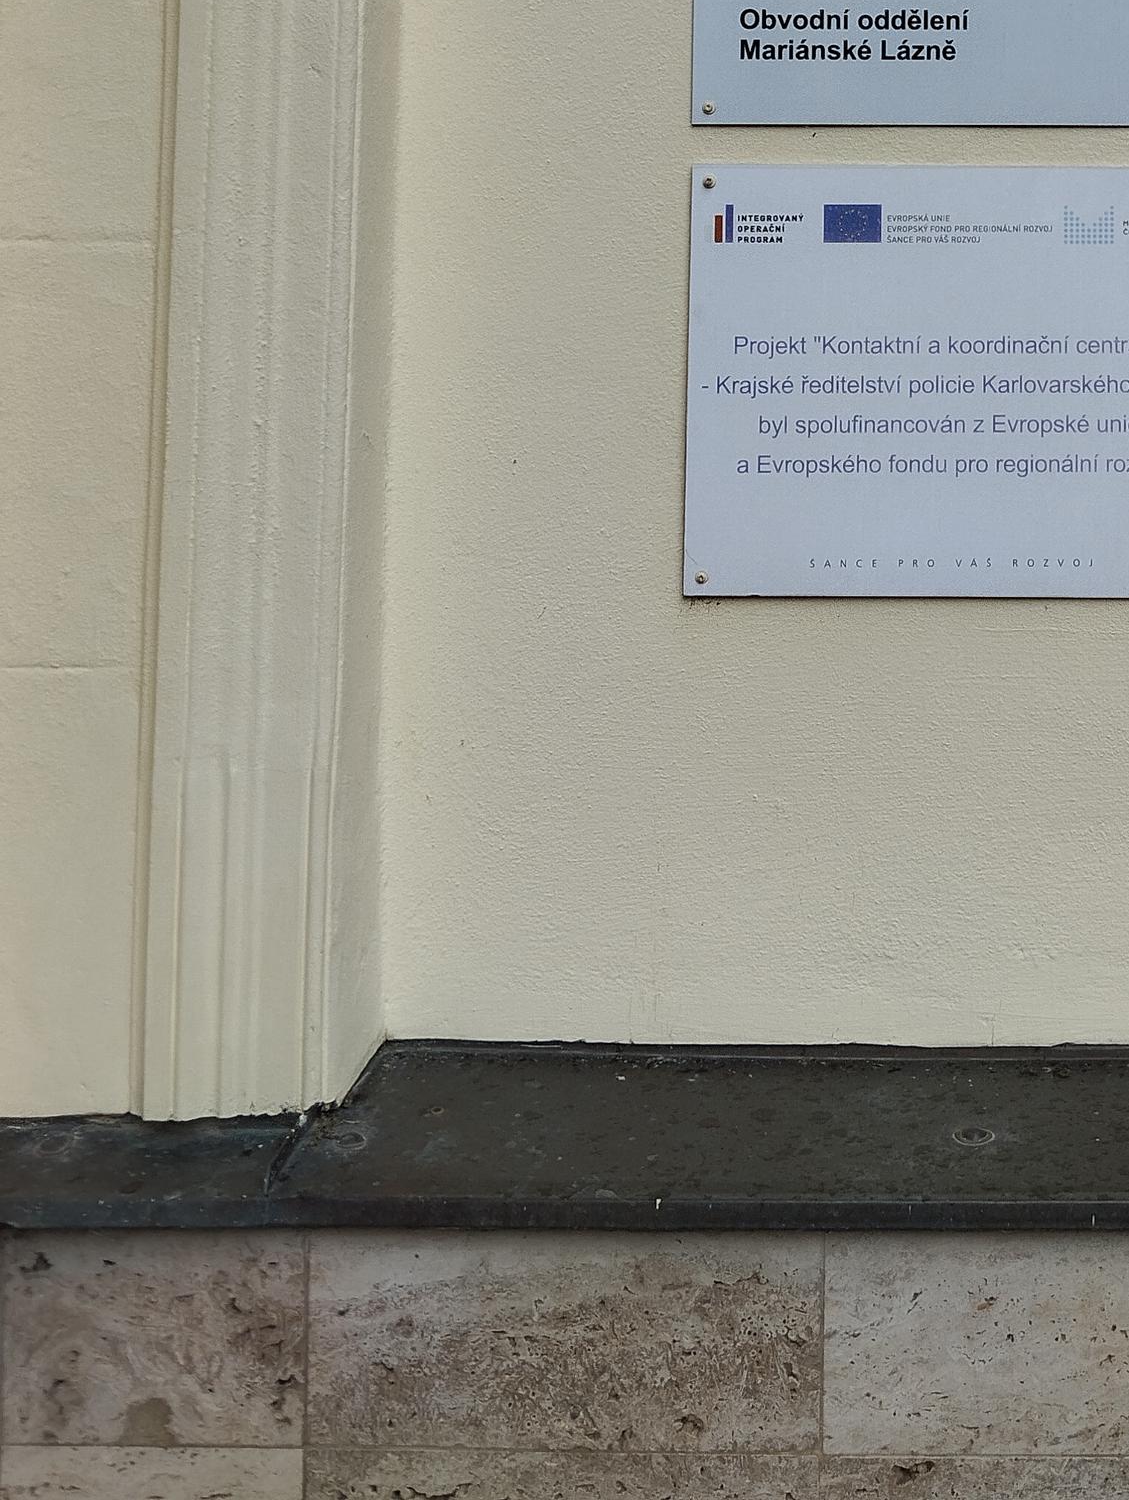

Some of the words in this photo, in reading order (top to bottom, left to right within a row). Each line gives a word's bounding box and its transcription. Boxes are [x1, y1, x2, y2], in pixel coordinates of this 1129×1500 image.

[739, 8, 851, 31] Obvodní
[857, 8, 970, 31] oddělení
[739, 38, 872, 62] Mariánské
[880, 39, 957, 62] Lázně
[737, 213, 804, 222] INTEGROVANÝ
[886, 213, 929, 222] EVROPSKÁ
[930, 214, 951, 222] UNIE
[737, 223, 785, 233] OPERAČNÍ
[886, 223, 929, 233] EVROPSKÝ
[929, 224, 953, 233] FOND
[954, 224, 971, 233] PRO
[972, 223, 1022, 233] REGIONÁLNÍ
[1023, 224, 1053, 233] ROZVOJ
[737, 235, 783, 244] PROGRAM
[886, 234, 914, 244] ŠANCE
[915, 235, 933, 244] PRO
[933, 234, 950, 244] VÁŠ
[951, 235, 981, 244] ROZVOJ
[733, 335, 807, 359] Projekt
[813, 335, 922, 356] "Kontaktní
[928, 339, 941, 356] a
[948, 335, 1070, 356] koordinační
[716, 375, 794, 399] Krajské
[801, 374, 902, 395] ředitelství
[908, 374, 976, 399] policie
[758, 414, 789, 439] byl
[795, 414, 966, 438] spolufinancován
[972, 419, 985, 434] z
[992, 413, 1090, 439] Evropské
[736, 459, 750, 474] a
[756, 454, 882, 479] Evropského
[888, 453, 948, 474] fondu
[955, 458, 989, 479] pro
[996, 453, 1099, 478] regionální
[898, 559, 936, 568] PRO
[1012, 558, 1093, 568] ROZVOJ
